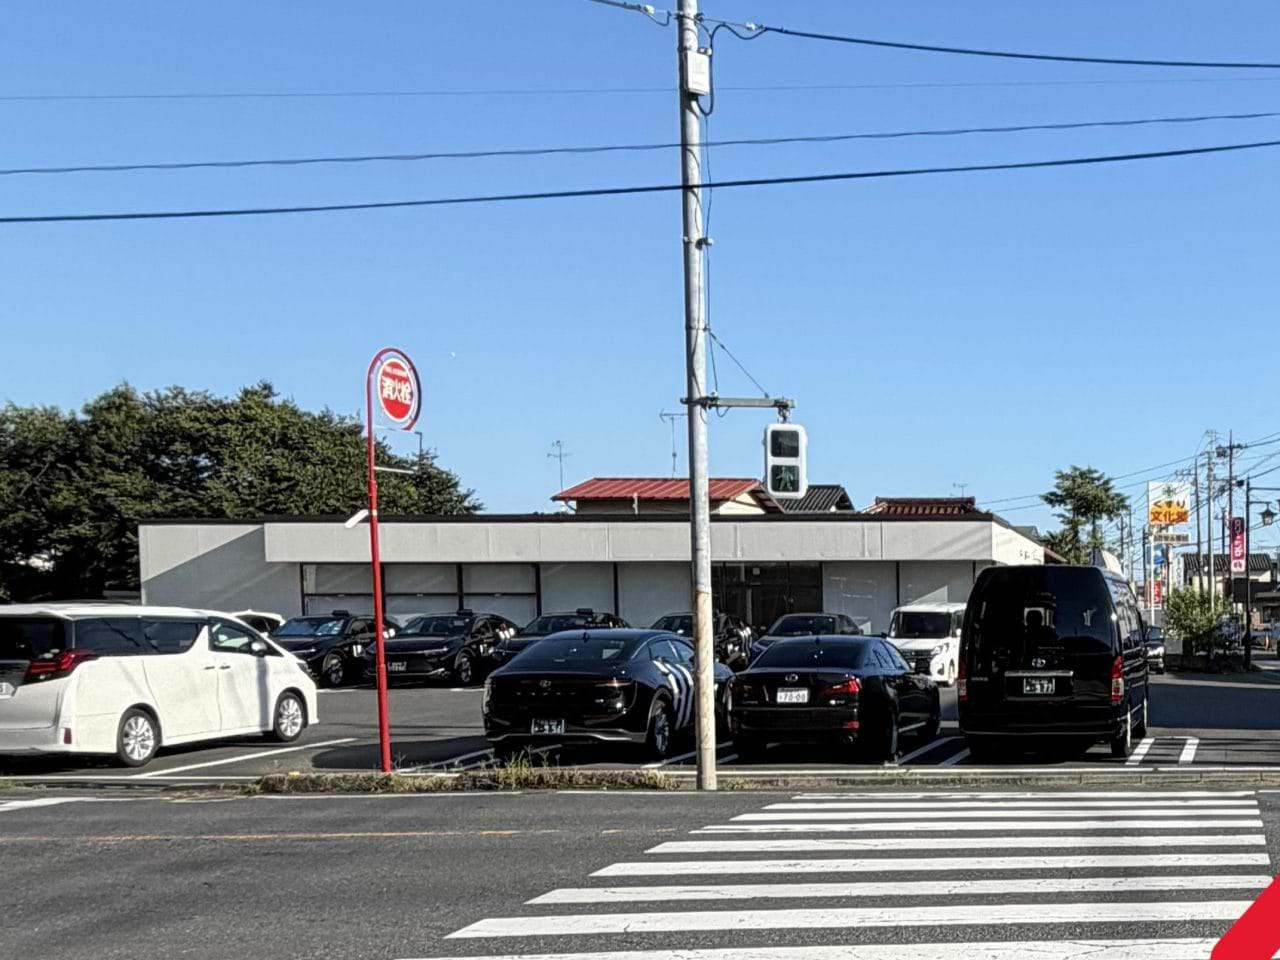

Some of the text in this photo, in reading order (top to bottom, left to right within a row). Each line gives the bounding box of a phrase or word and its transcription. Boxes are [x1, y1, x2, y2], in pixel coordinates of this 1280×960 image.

[381, 375, 412, 405] 消火栓
[1153, 499, 1186, 509] くすり
